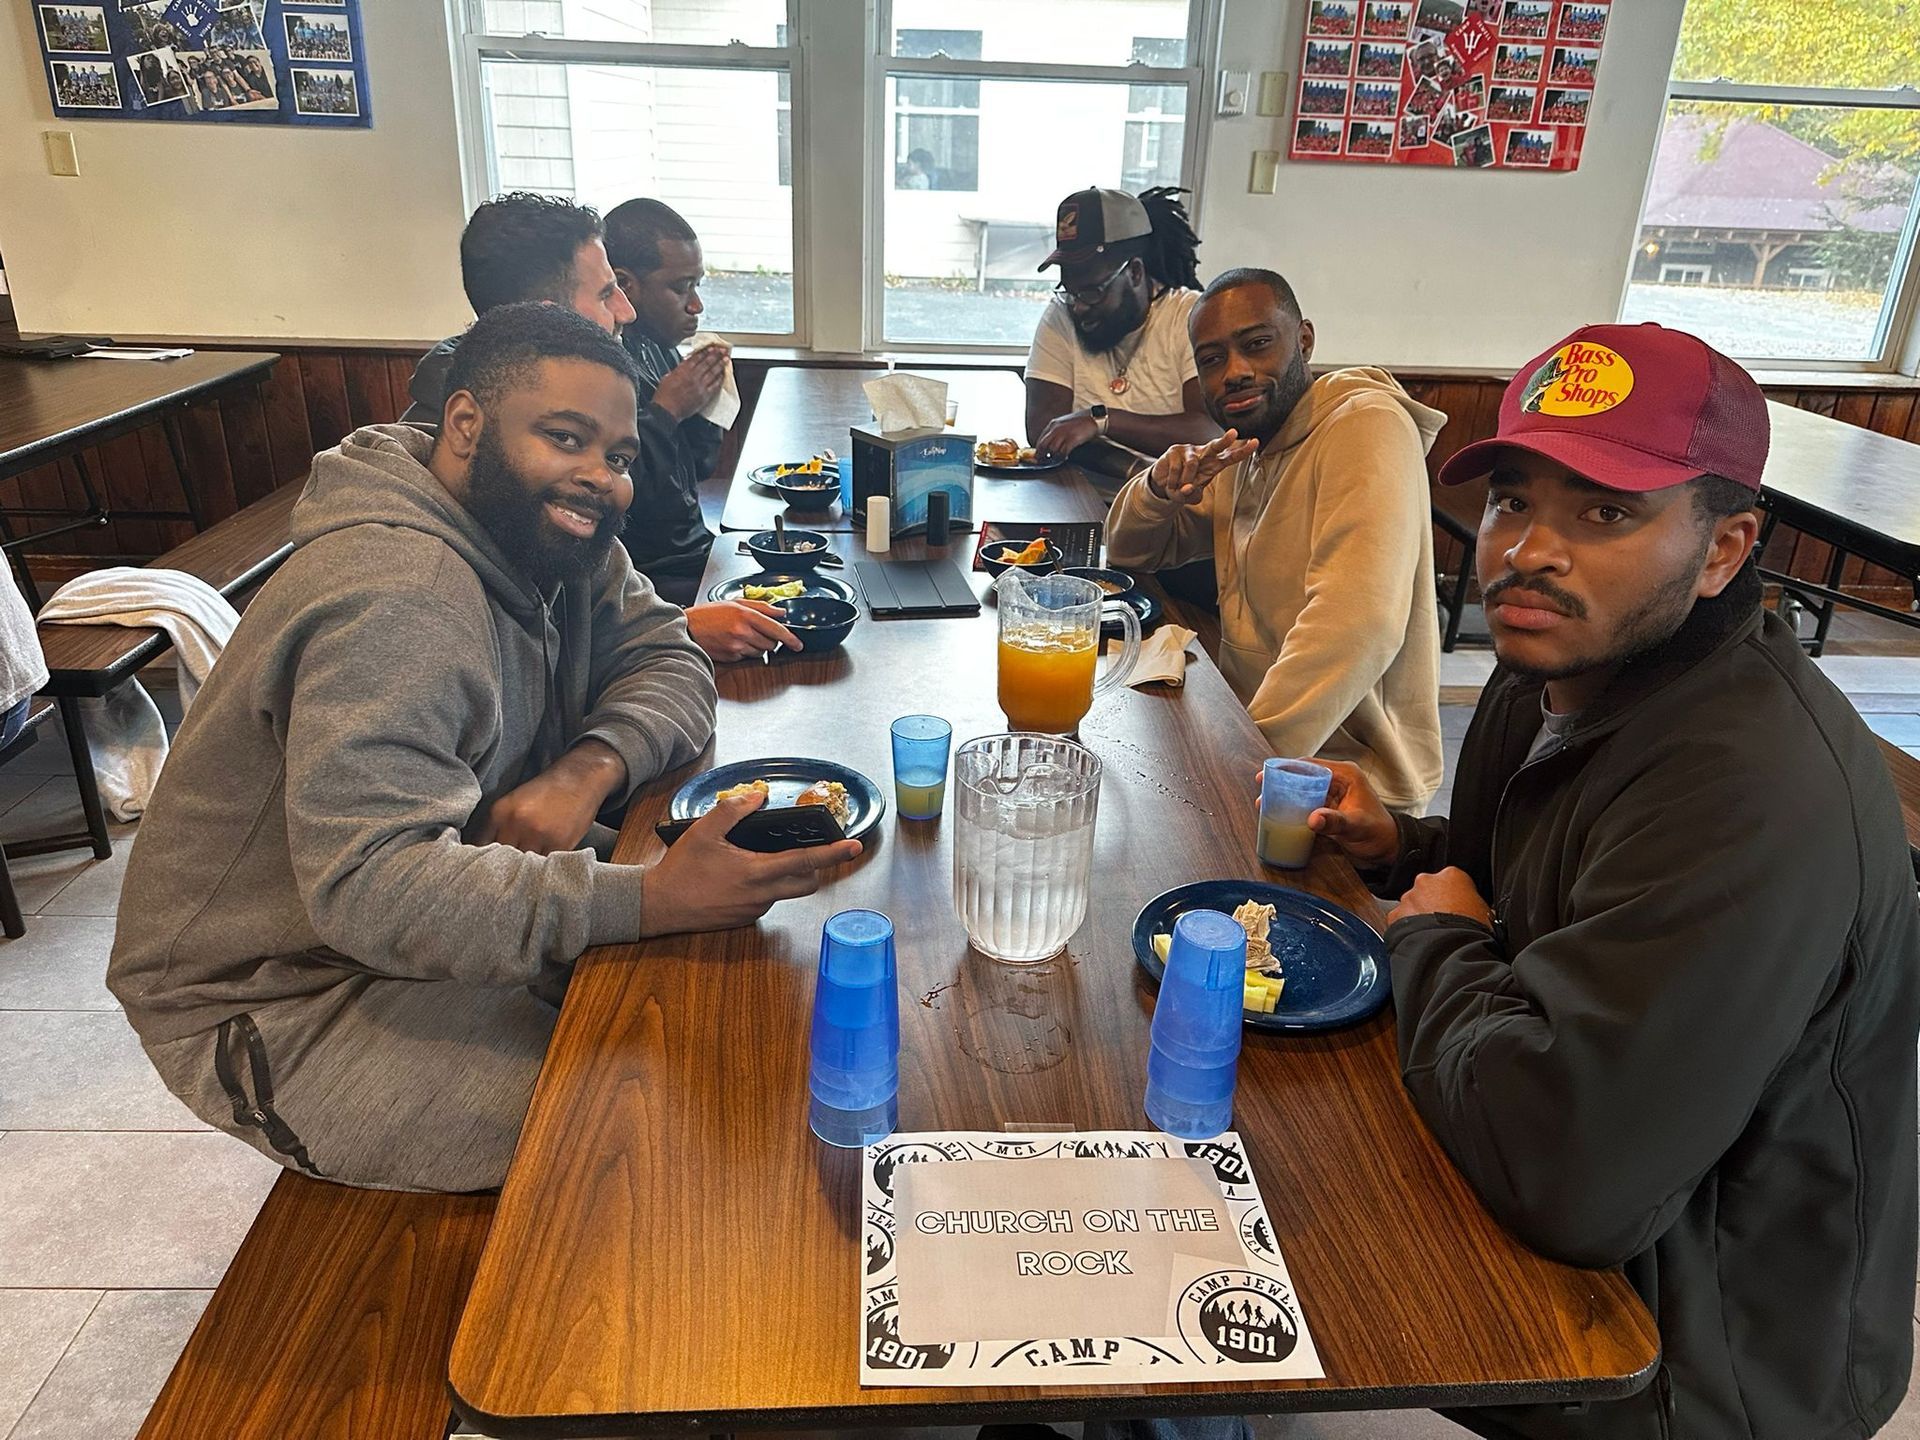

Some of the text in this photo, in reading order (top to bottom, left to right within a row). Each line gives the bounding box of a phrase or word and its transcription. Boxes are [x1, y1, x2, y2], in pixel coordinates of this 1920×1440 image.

[1455, 20, 1491, 41] CAMP JEWELL
[1565, 344, 1617, 366] Bass
[1562, 364, 1597, 383] Pro
[1556, 383, 1619, 408] Shops
[984, 1141, 1036, 1155] YMCA
[1192, 1145, 1247, 1179] 1901
[915, 1208, 1219, 1234] CHURCH ON THE
[1016, 1250, 1133, 1276] ROCK
[1188, 1275, 1230, 1304] CAMP
[867, 1337, 928, 1369] 1901
[1025, 1338, 1119, 1367] CAMP
[1217, 1325, 1276, 1357] 1901
